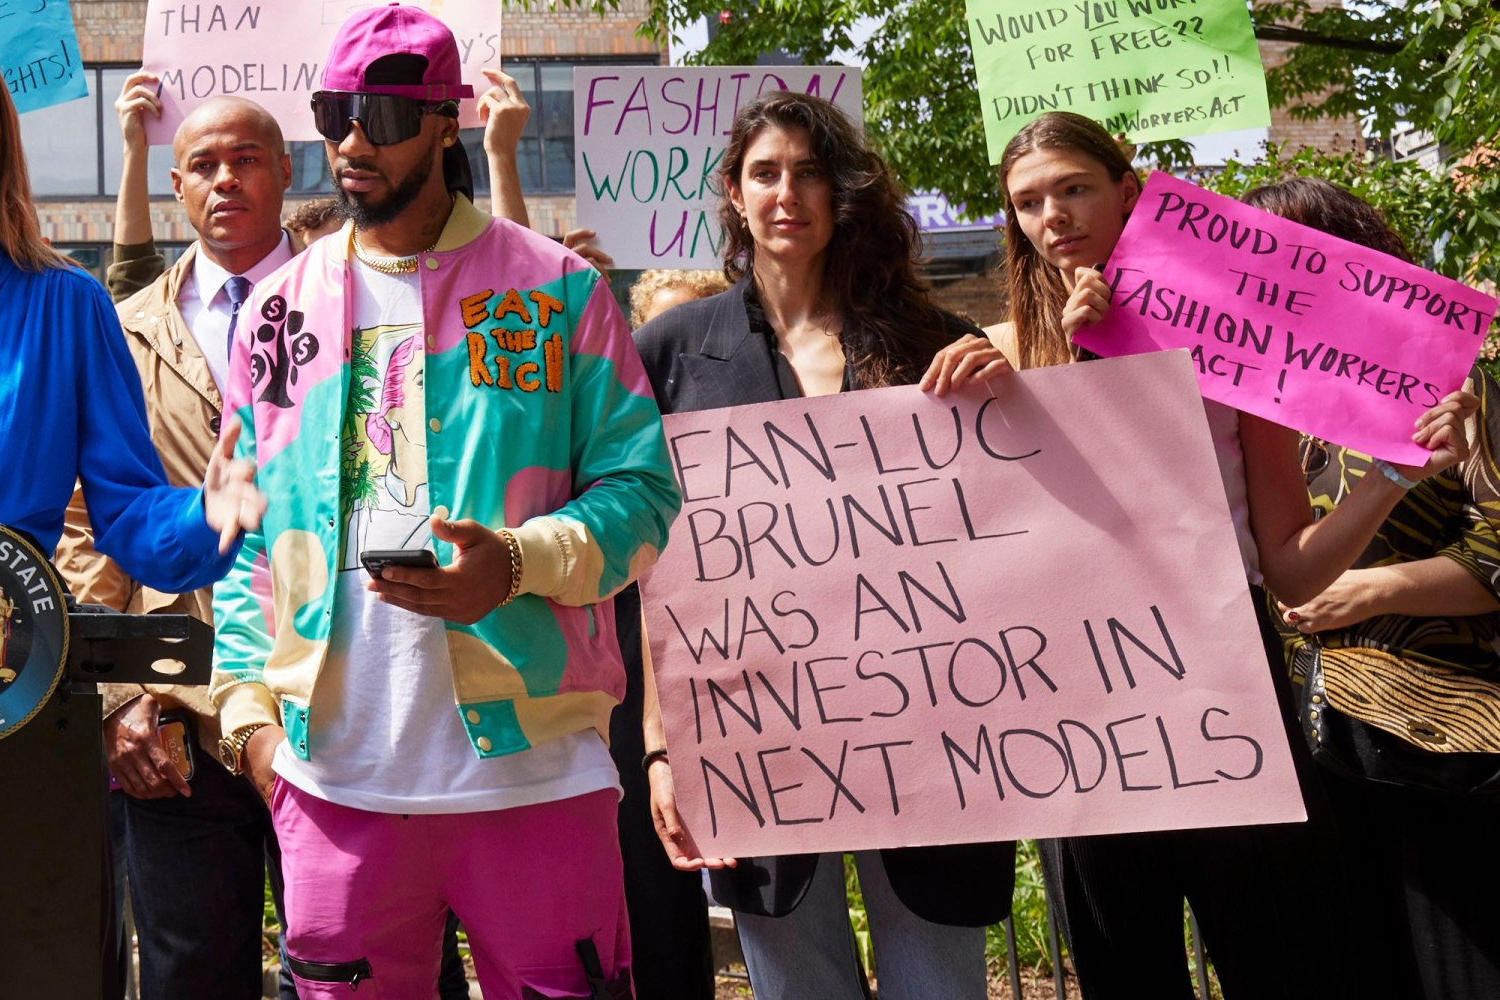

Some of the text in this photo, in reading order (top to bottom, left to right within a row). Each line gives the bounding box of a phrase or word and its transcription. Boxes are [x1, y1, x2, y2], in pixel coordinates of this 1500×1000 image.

[160, 5, 262, 37] THAN
[976, 6, 1068, 46] WOULD
[1074, 0, 1120, 31] YOU
[1026, 16, 1206, 71] FOR FREE??
[156, 63, 325, 102] MODELIN
[992, 54, 1235, 121] DIDN'T THINK SO!!
[1153, 191, 1493, 336] PROUD TO SUPPORT
[1227, 268, 1318, 316] THE
[460, 288, 565, 329] EAT
[1110, 266, 1442, 409] FASHION WORKERS
[465, 332, 563, 393] RICH
[489, 328, 537, 354] THE
[686, 475, 1030, 583] BRUNEL
[664, 560, 968, 666] WAS AN
[688, 603, 1187, 745] INVESTOR IN
[699, 706, 1265, 839] NEXT MODELS
